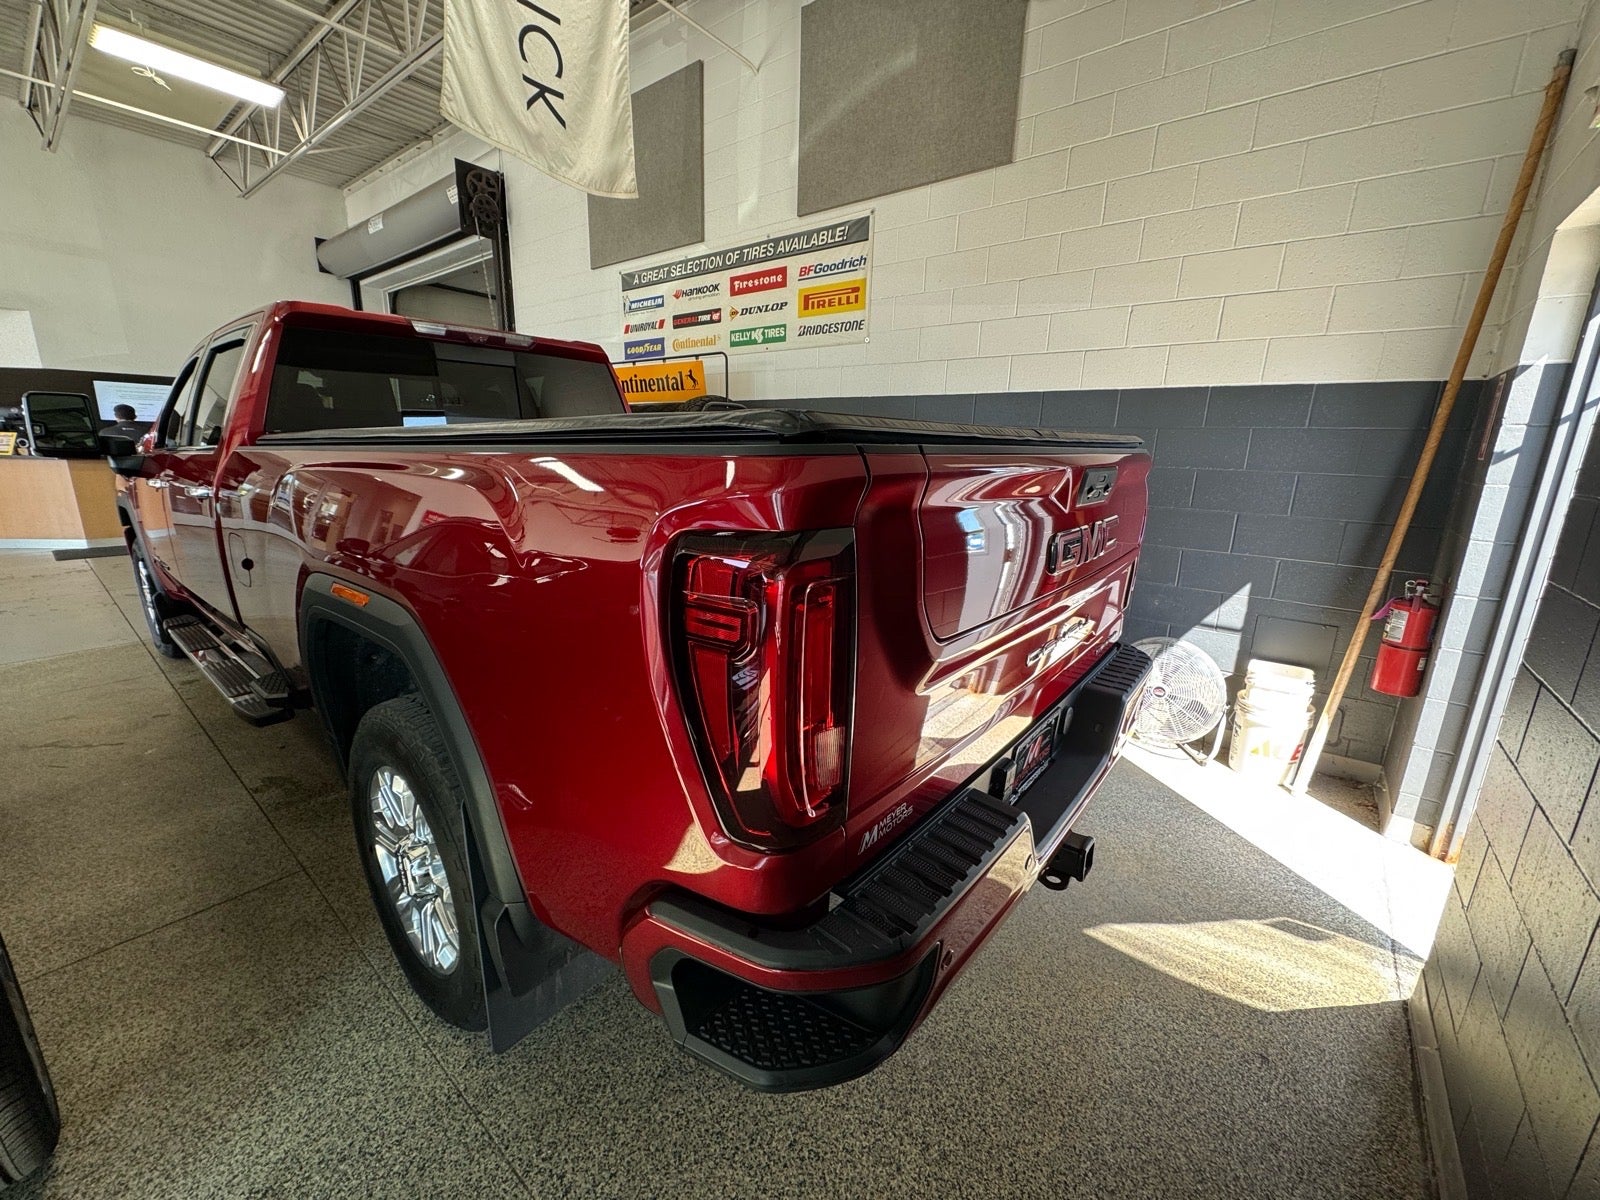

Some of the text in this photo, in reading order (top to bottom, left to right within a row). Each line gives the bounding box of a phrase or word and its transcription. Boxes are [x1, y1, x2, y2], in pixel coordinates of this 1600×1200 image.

[516, 0, 566, 130] ICK
[633, 225, 849, 285] A GREAT SELECTION OF TIRES AVAILABLE!
[798, 255, 867, 278] BFGoodrich
[733, 273, 783, 291] Firestone
[630, 297, 663, 309] MICHELIN
[803, 286, 860, 311] PIRELLI
[740, 301, 788, 316] DUNLOP
[630, 321, 658, 333] UNIROYAL
[730, 331, 751, 342] KELLY
[764, 327, 785, 338] TIRES
[798, 319, 865, 336] BRIDGESTONE
[627, 342, 662, 355] GOODYEAR
[672, 334, 717, 352] Continental
[1046, 514, 1120, 576] GMC
[879, 802, 907, 830] MEYER
[879, 805, 914, 839] MOTORS
